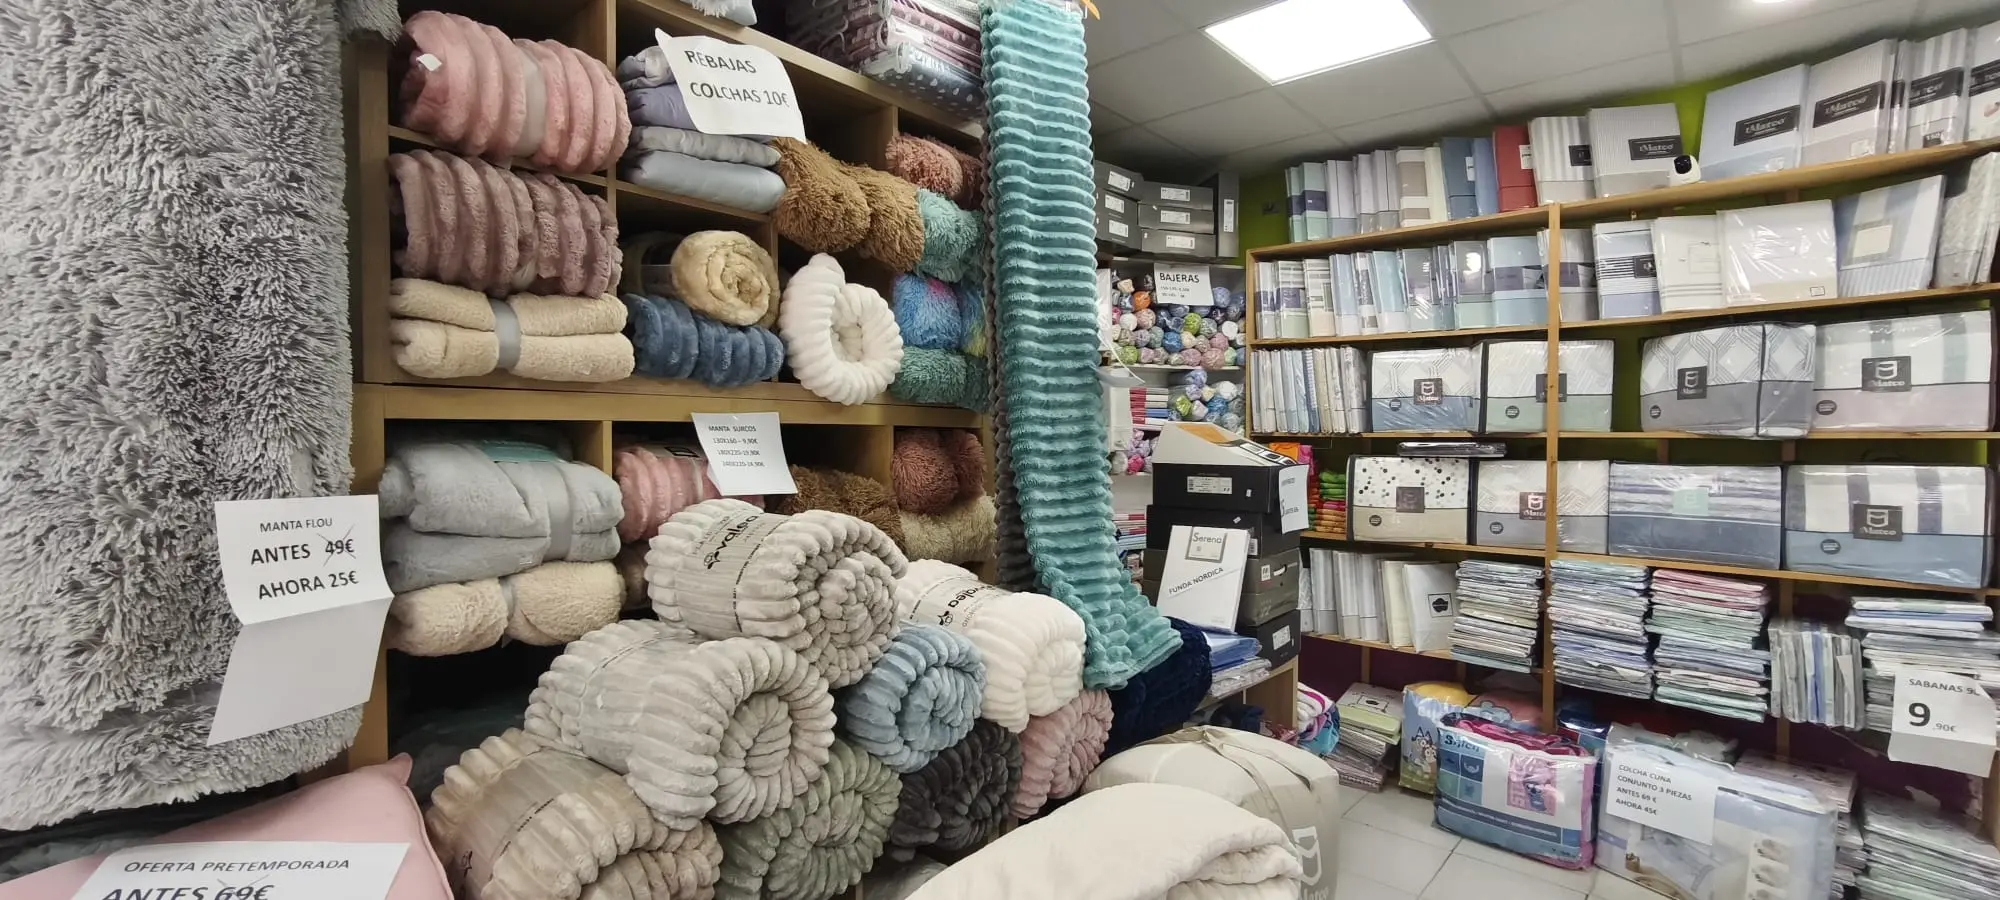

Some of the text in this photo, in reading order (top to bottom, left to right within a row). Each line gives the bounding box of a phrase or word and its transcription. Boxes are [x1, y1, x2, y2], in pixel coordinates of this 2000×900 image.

[684, 50, 757, 74] REBAJAS
[690, 82, 790, 107] COLCHAS 10€
[1159, 272, 1200, 284] BAJERAS
[259, 517, 333, 533] MANTA FLOU
[715, 514, 760, 552] valea
[1192, 532, 1222, 544] Serena
[251, 538, 355, 565] ANTES 49€
[259, 570, 359, 600] AHORA 25€
[1168, 566, 1224, 595] FUNDA NORDICA
[1908, 678, 1963, 693] SABANAS
[1908, 702, 1931, 727] 9
[1618, 764, 1672, 784] COLCHA CUNA
[1616, 786, 1640, 798] ANTES
[1617, 775, 1658, 791] CONJUNTO
[1666, 788, 1693, 801] PIEZAS
[1615, 798, 1642, 811] AHORA
[124, 859, 350, 873] OFERTA PRETEMPORADA
[101, 884, 274, 900] ANTES 69€
